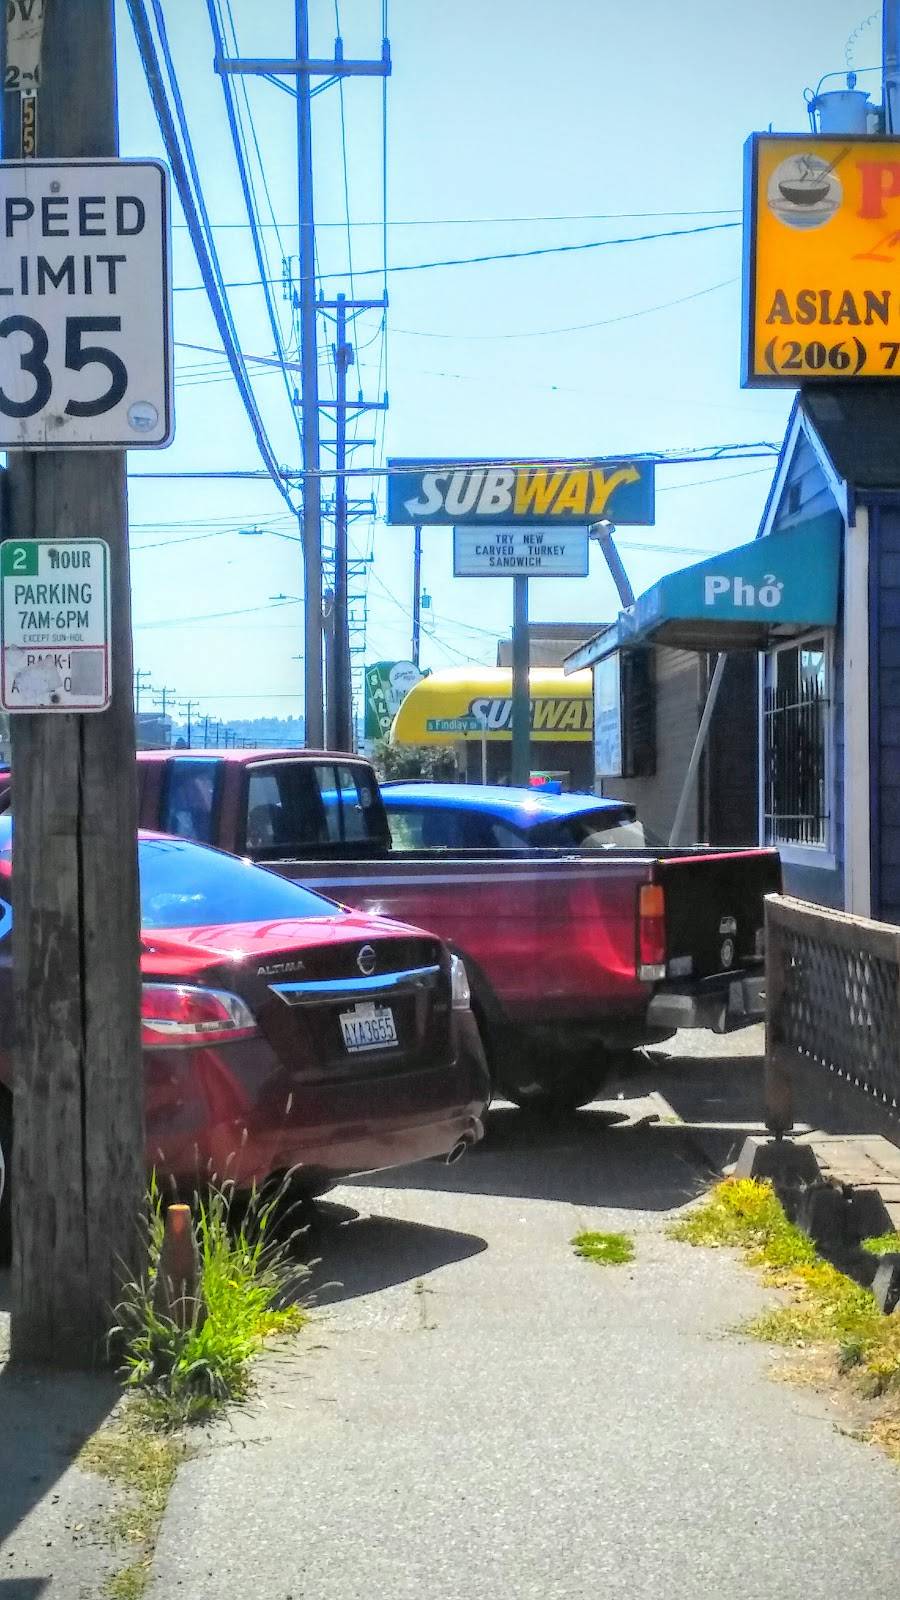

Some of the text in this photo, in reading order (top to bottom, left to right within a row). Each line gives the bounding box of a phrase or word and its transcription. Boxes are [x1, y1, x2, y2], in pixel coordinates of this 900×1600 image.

[6, 196, 146, 238] PEED
[765, 288, 891, 326] ASIAN
[0, 314, 129, 418] 35
[764, 335, 867, 375] (206)
[404, 467, 640, 517] SUBWAY
[495, 533, 544, 545] TRY NEW
[13, 547, 91, 570] 2 HOUR
[475, 545, 566, 556] CARVED TURKEY
[489, 556, 542, 567] SANDWICH
[14, 583, 92, 605] PARKING
[18, 610, 89, 630] 7AM-6PM
[23, 634, 50, 643] EXCEPT
[435, 719, 467, 731] Findlay
[471, 699, 593, 730] SUWA
[257, 960, 306, 977] ALTIMA
